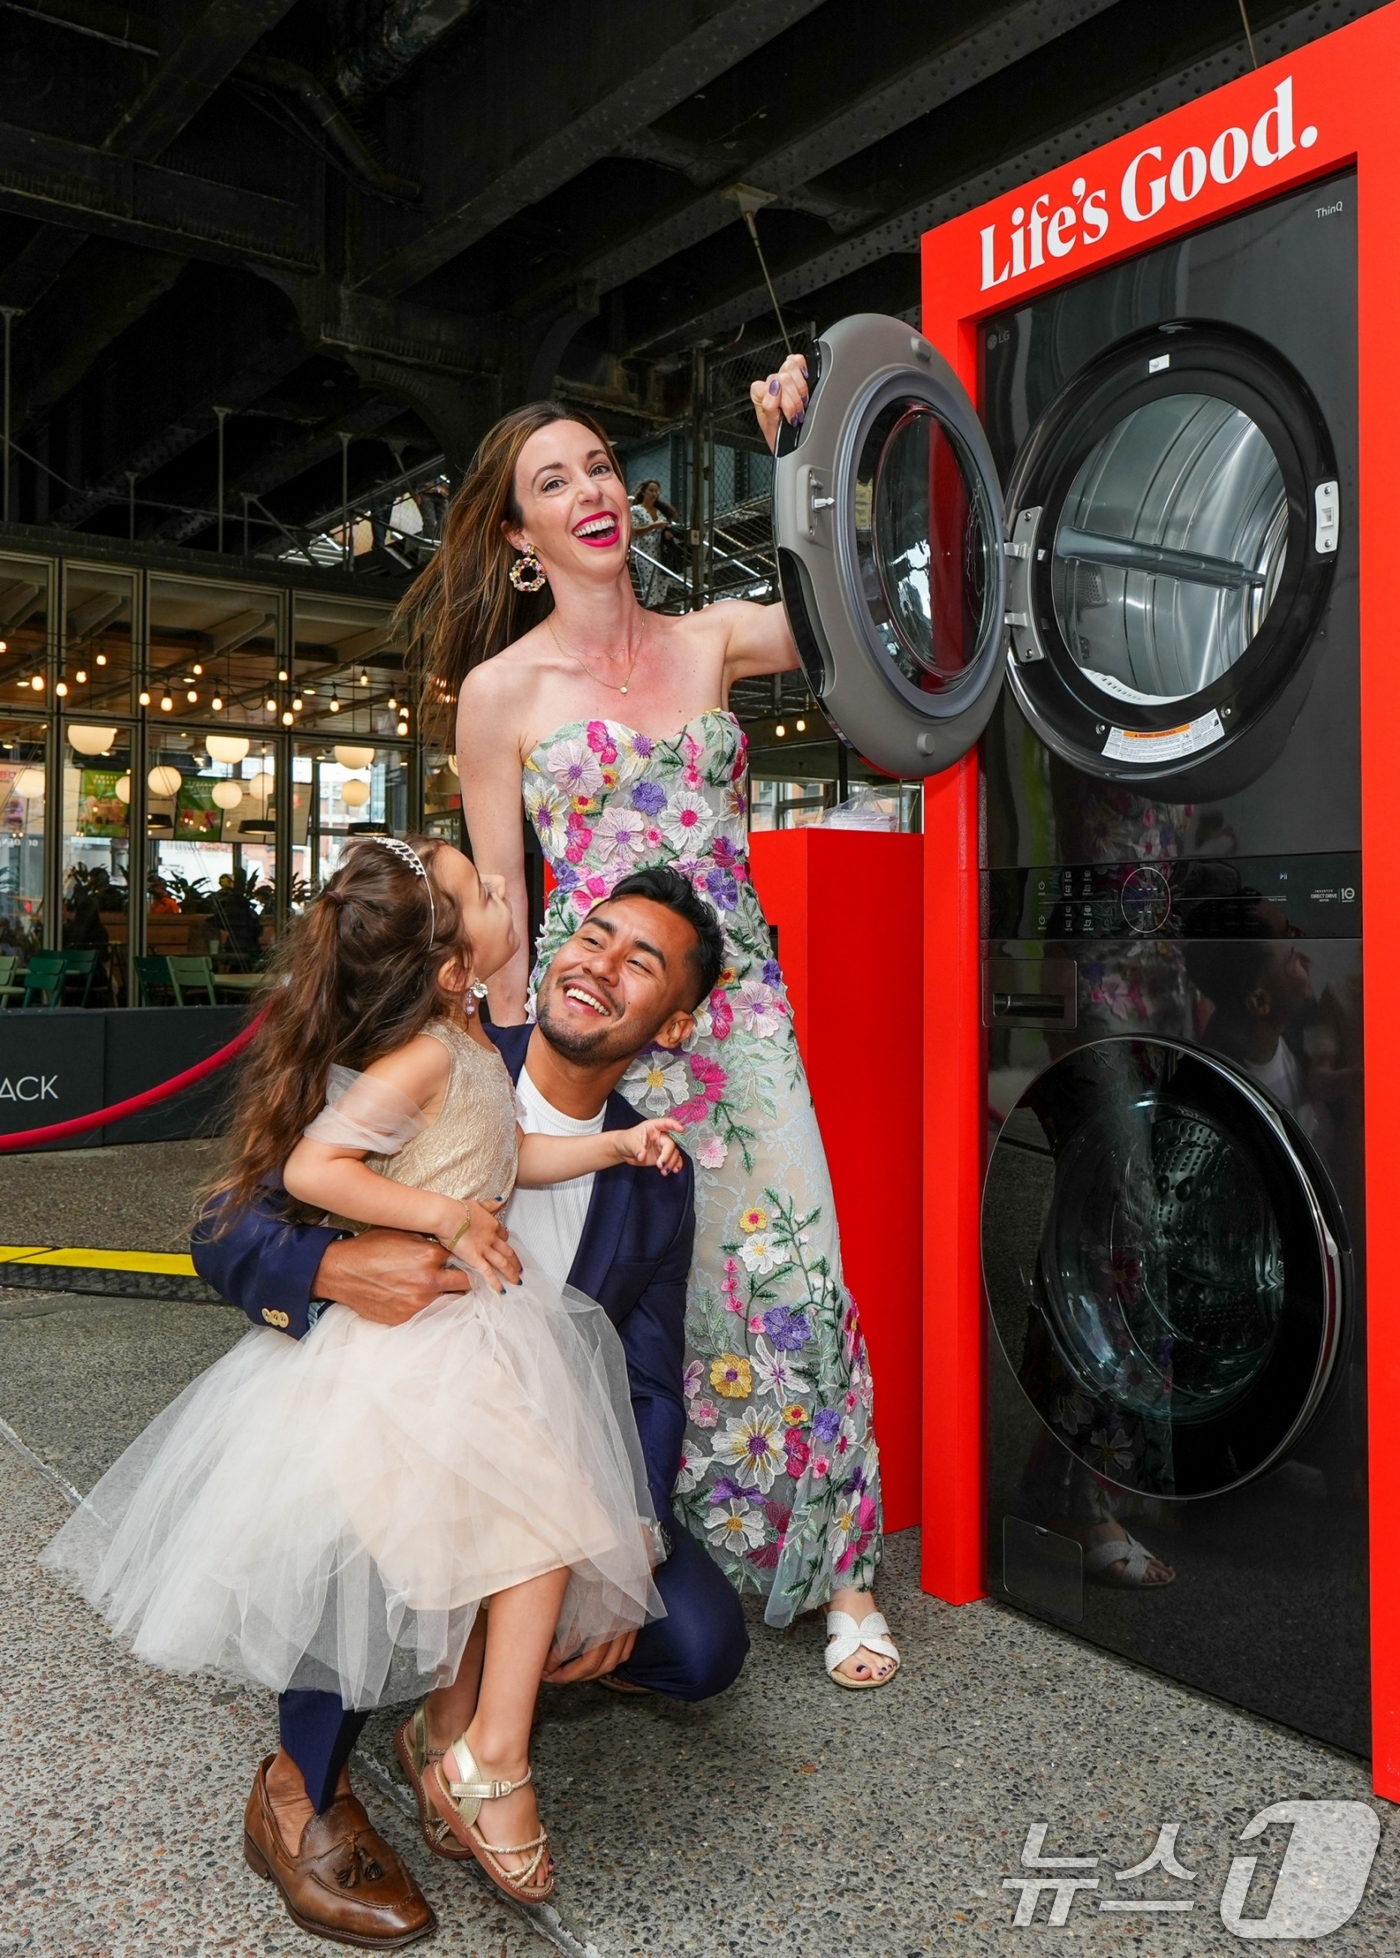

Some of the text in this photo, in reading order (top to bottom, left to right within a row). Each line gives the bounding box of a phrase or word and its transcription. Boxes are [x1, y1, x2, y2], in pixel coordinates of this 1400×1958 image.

[979, 75, 1319, 292] Life's Good.
[1315, 200, 1343, 219] ThinQ
[998, 329, 1011, 344] LG
[1341, 887, 1355, 899] 10
[0, 1074, 59, 1102] ACK
